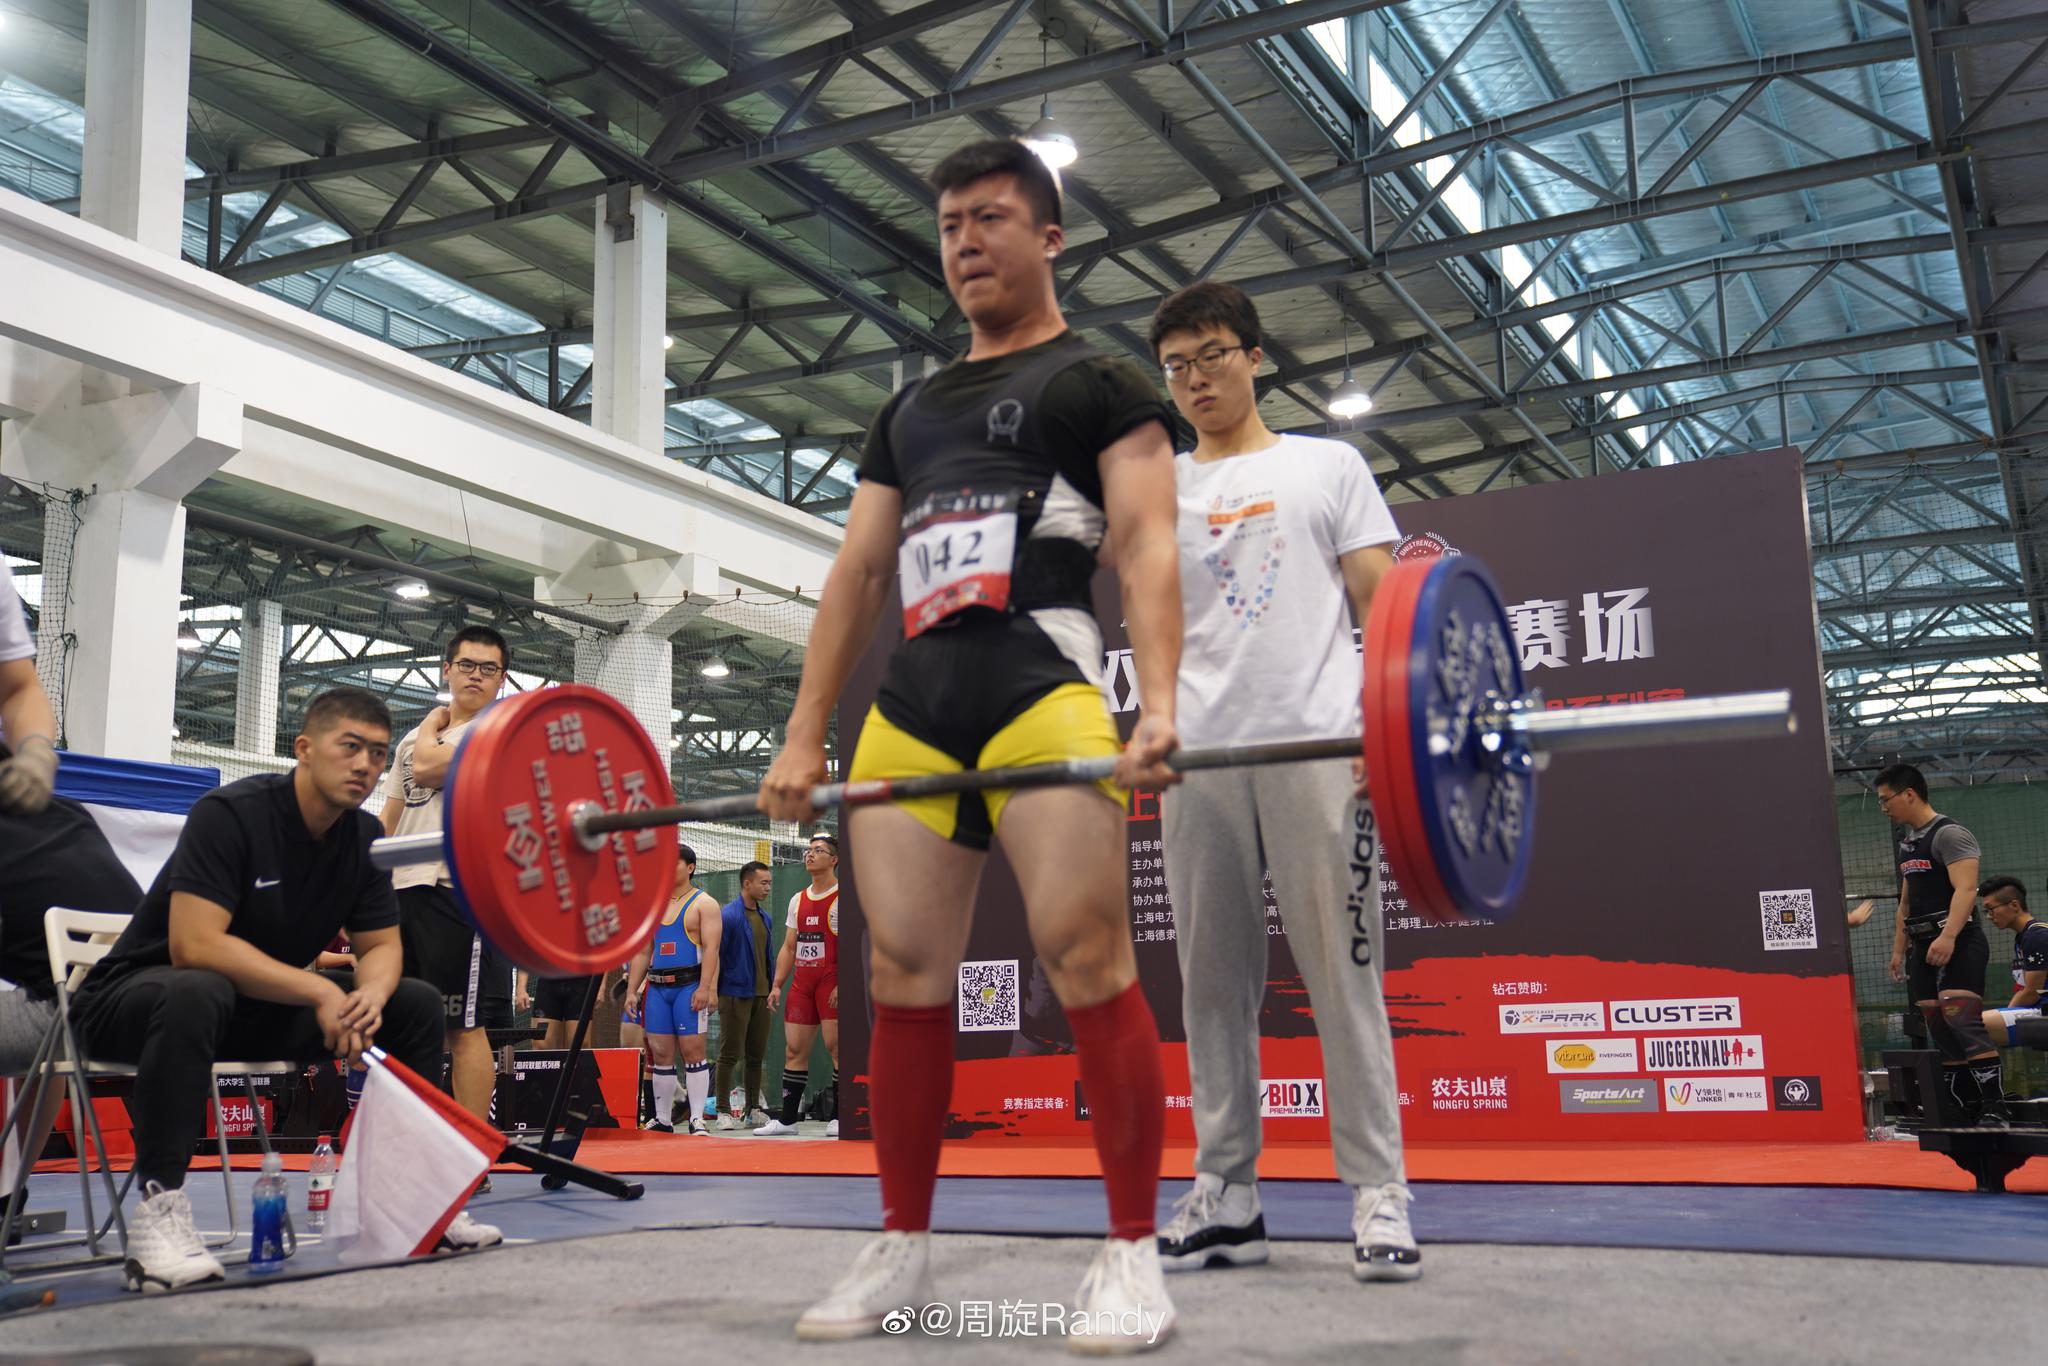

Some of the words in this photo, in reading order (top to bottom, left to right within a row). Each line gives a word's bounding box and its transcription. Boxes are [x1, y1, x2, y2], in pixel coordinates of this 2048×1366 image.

[1399, 539, 1441, 557] UNISTRENGTH
[1503, 587, 1655, 671] 赛场
[1614, 1004, 1733, 1024] CLUSTER
[1269, 1083, 1301, 1107] BIO
[1305, 1083, 1319, 1106] X
[1432, 1076, 1508, 1097] 农夫山泉
[1573, 1088, 1645, 1102] SportsArt
[1433, 1099, 1470, 1110] NONGFU
[1473, 1098, 1508, 1109] SPRING
